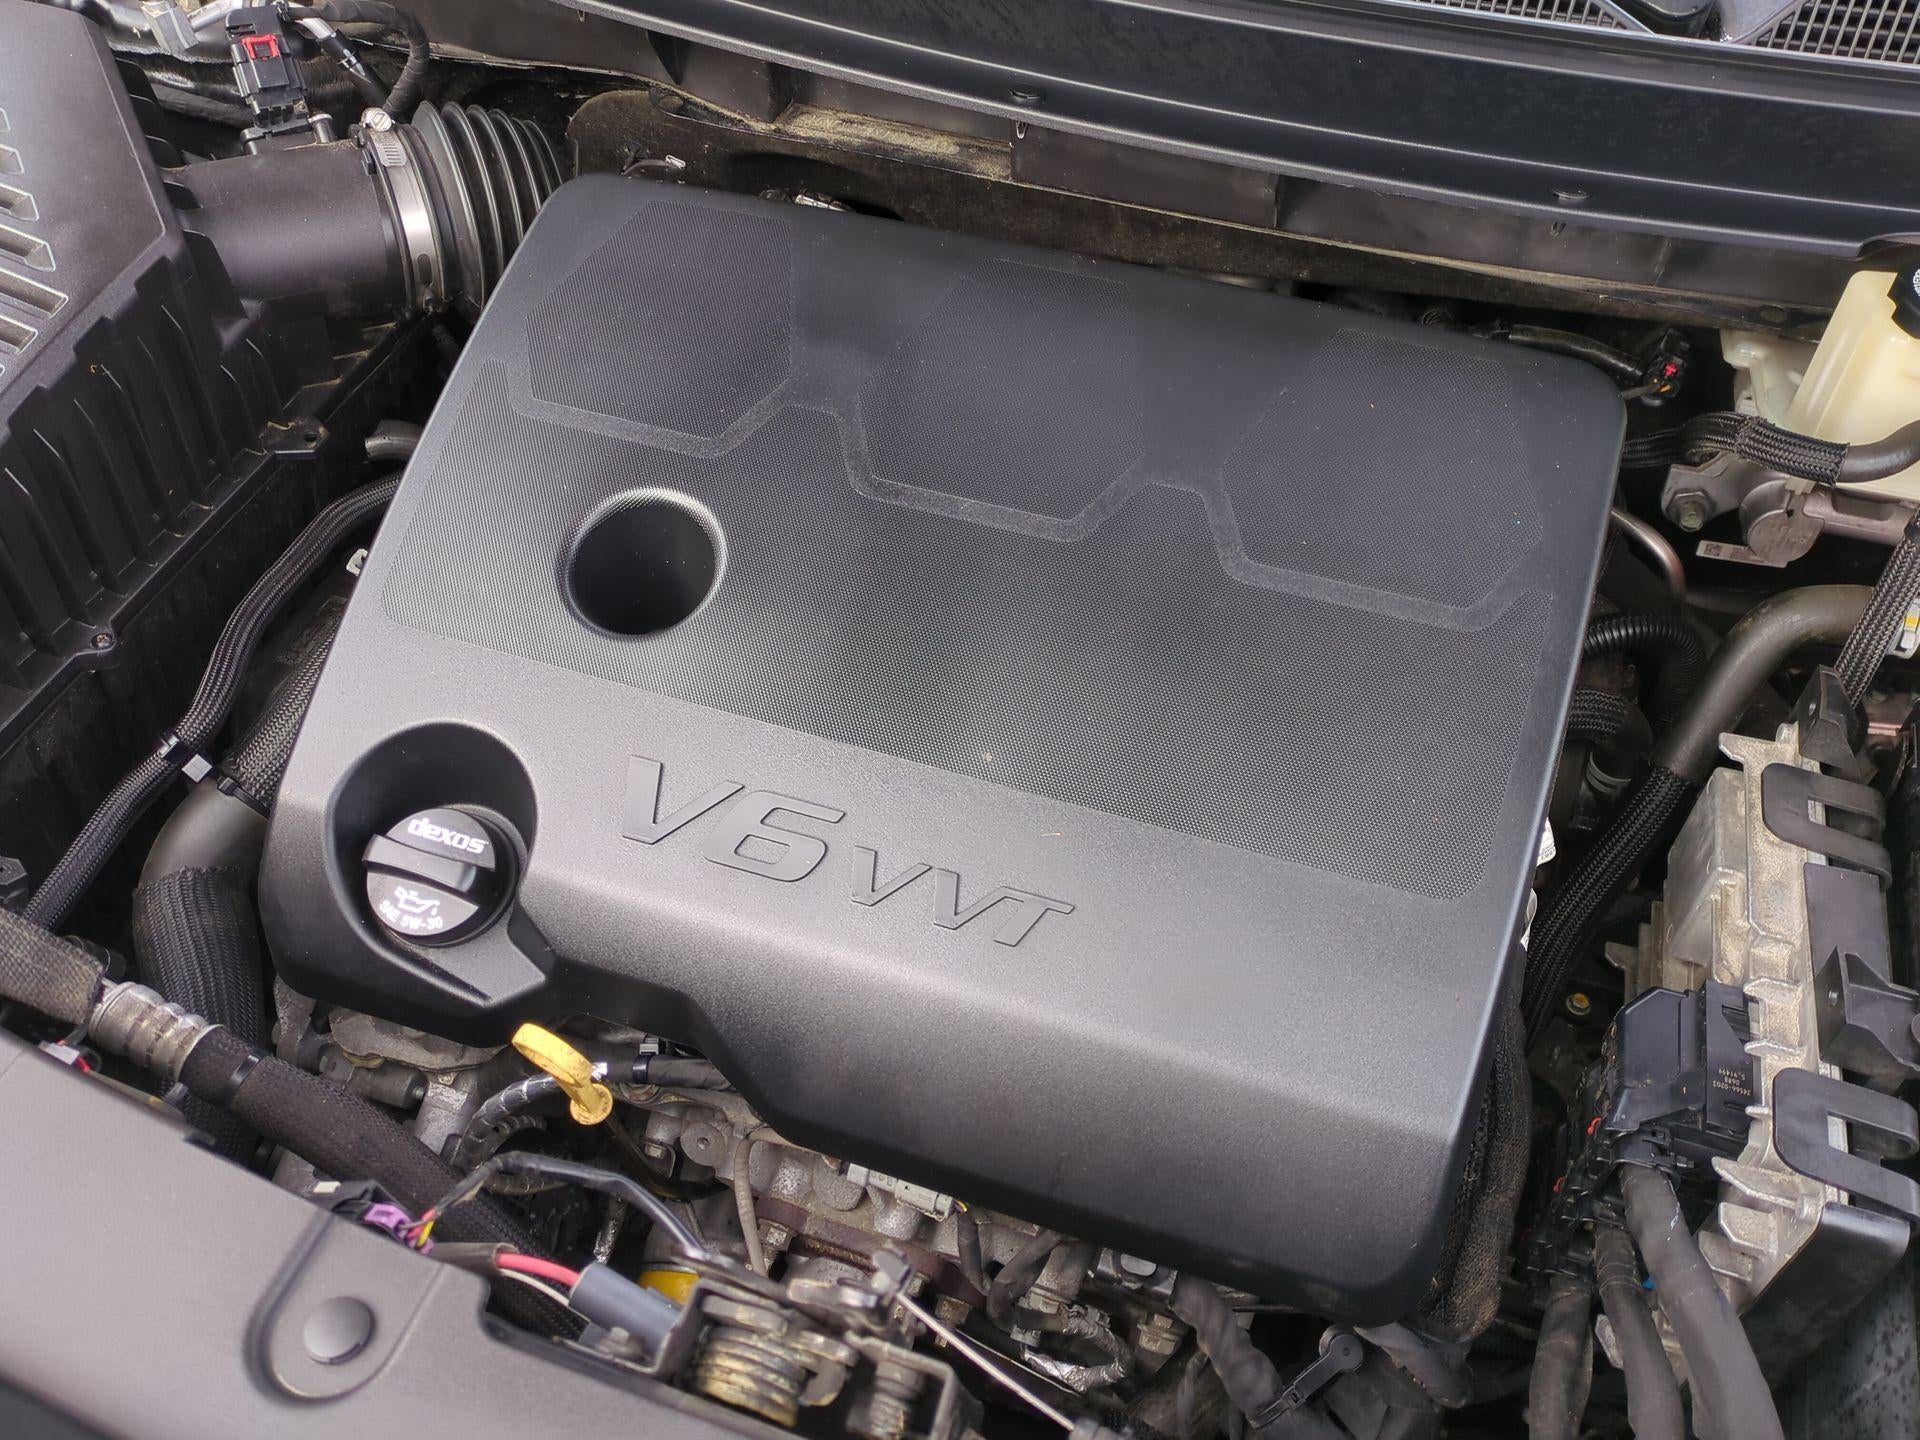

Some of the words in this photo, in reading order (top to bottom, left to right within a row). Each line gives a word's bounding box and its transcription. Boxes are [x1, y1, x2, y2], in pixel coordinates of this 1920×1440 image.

[407, 817, 485, 854] dexos
[621, 754, 846, 882] V6
[850, 844, 1076, 947] VVT
[379, 899, 401, 923] SAE
[401, 915, 443, 930] 5W-30
